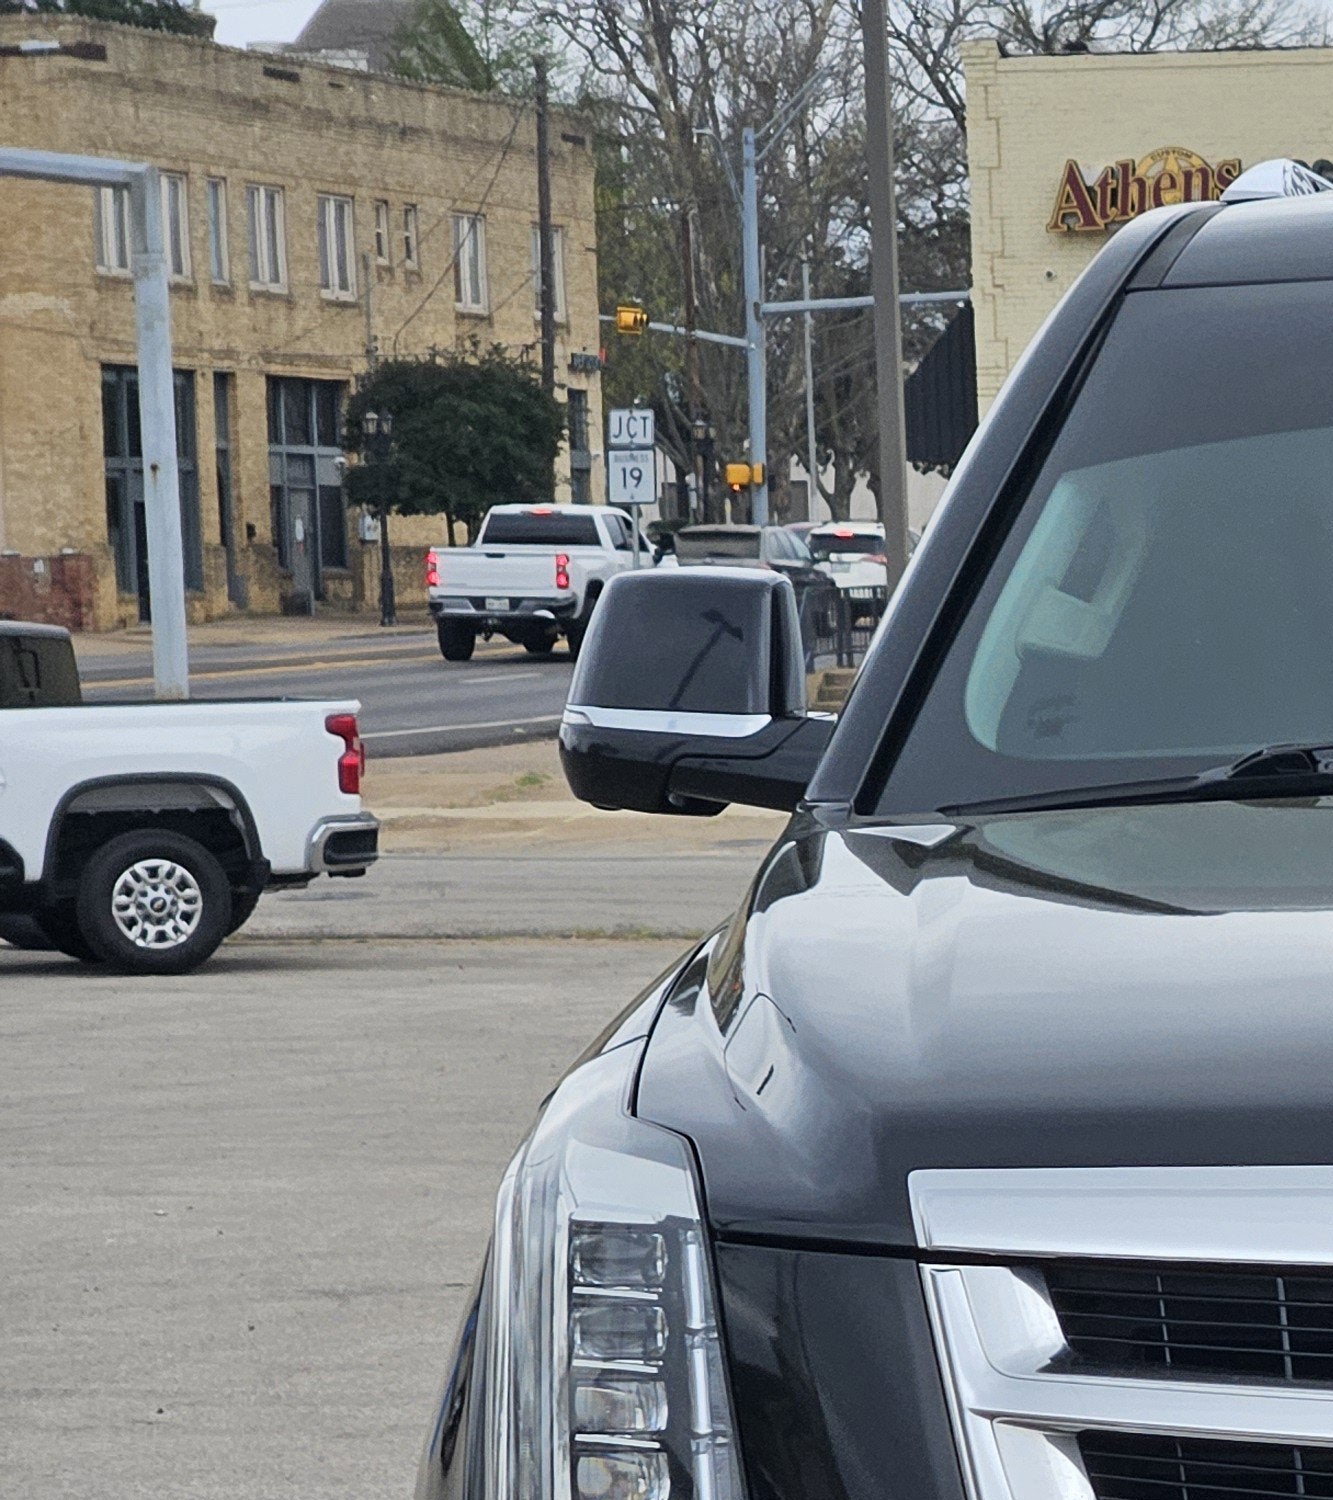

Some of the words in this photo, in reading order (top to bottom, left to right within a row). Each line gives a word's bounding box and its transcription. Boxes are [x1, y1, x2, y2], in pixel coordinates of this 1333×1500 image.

[1047, 158, 1241, 232] Athens
[613, 415, 649, 438] JCT
[621, 466, 643, 489] 19
